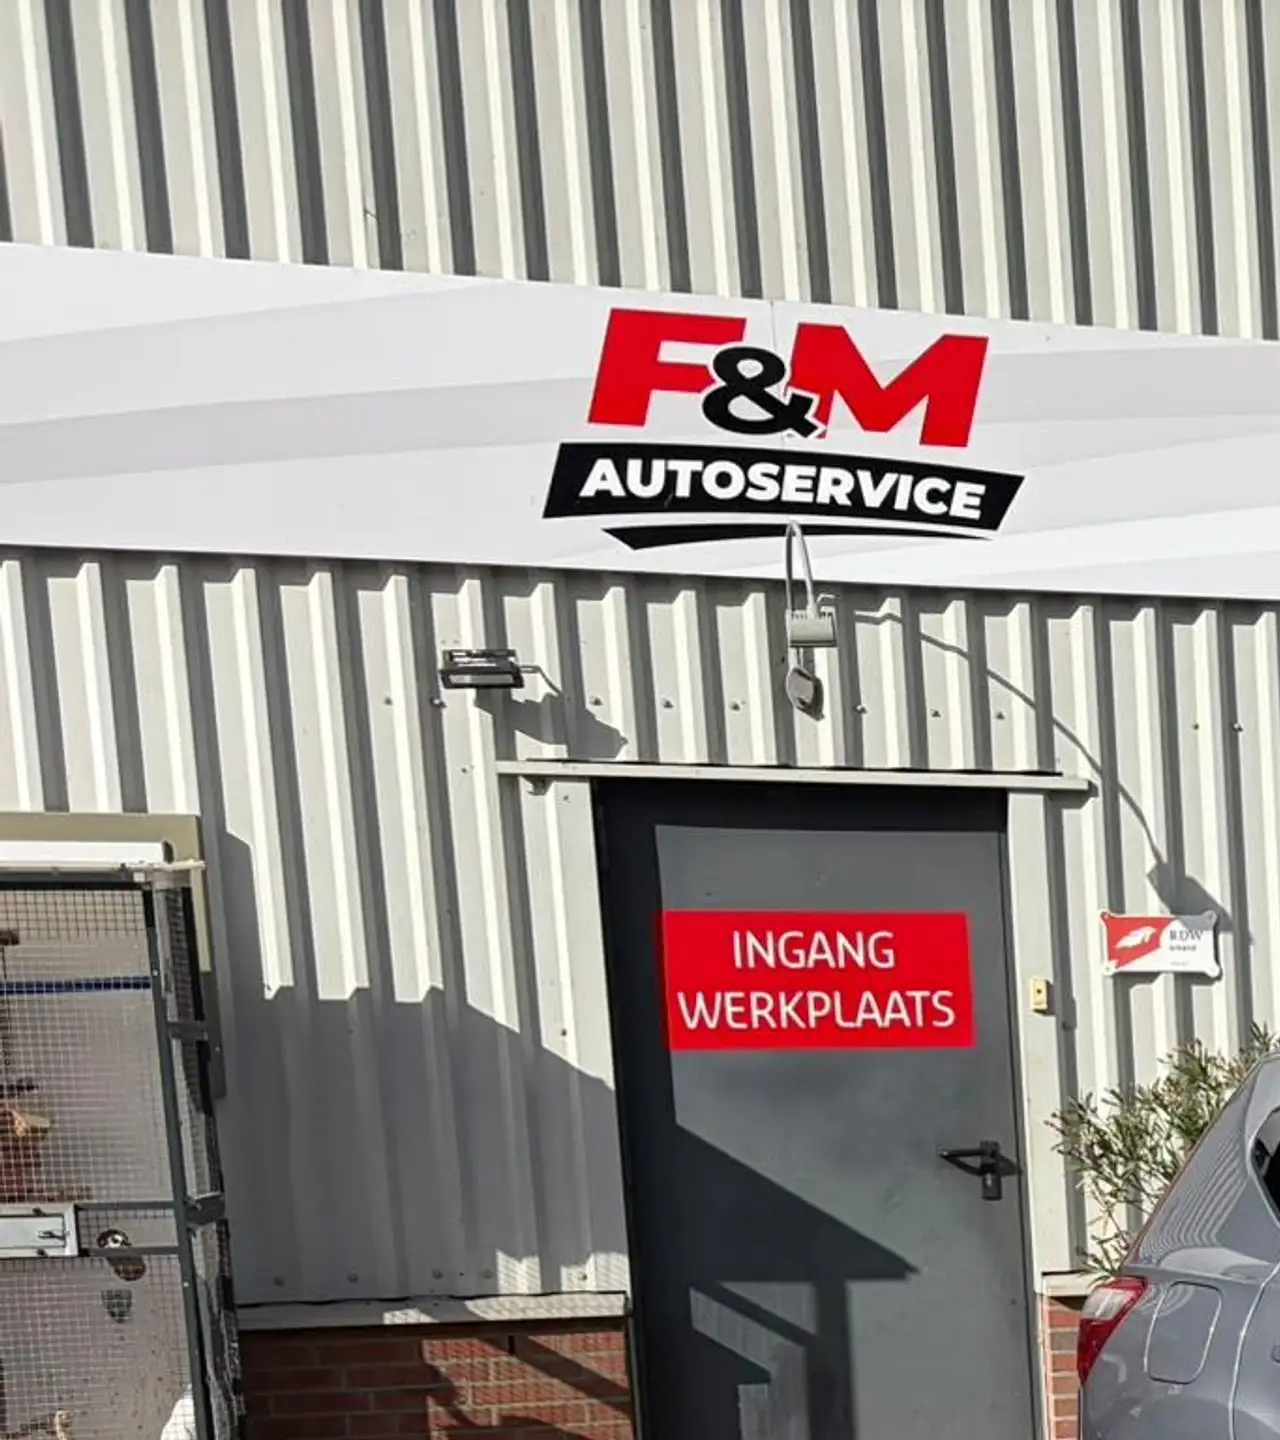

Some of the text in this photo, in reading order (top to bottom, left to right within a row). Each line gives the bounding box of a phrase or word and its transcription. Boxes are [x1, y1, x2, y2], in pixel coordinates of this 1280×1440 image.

[587, 308, 990, 448] F&M
[578, 458, 987, 521] AUTOSERVICE
[732, 929, 896, 970] INGANG
[1170, 929, 1204, 942] RDW
[677, 988, 956, 1031] WERKPLAATS
